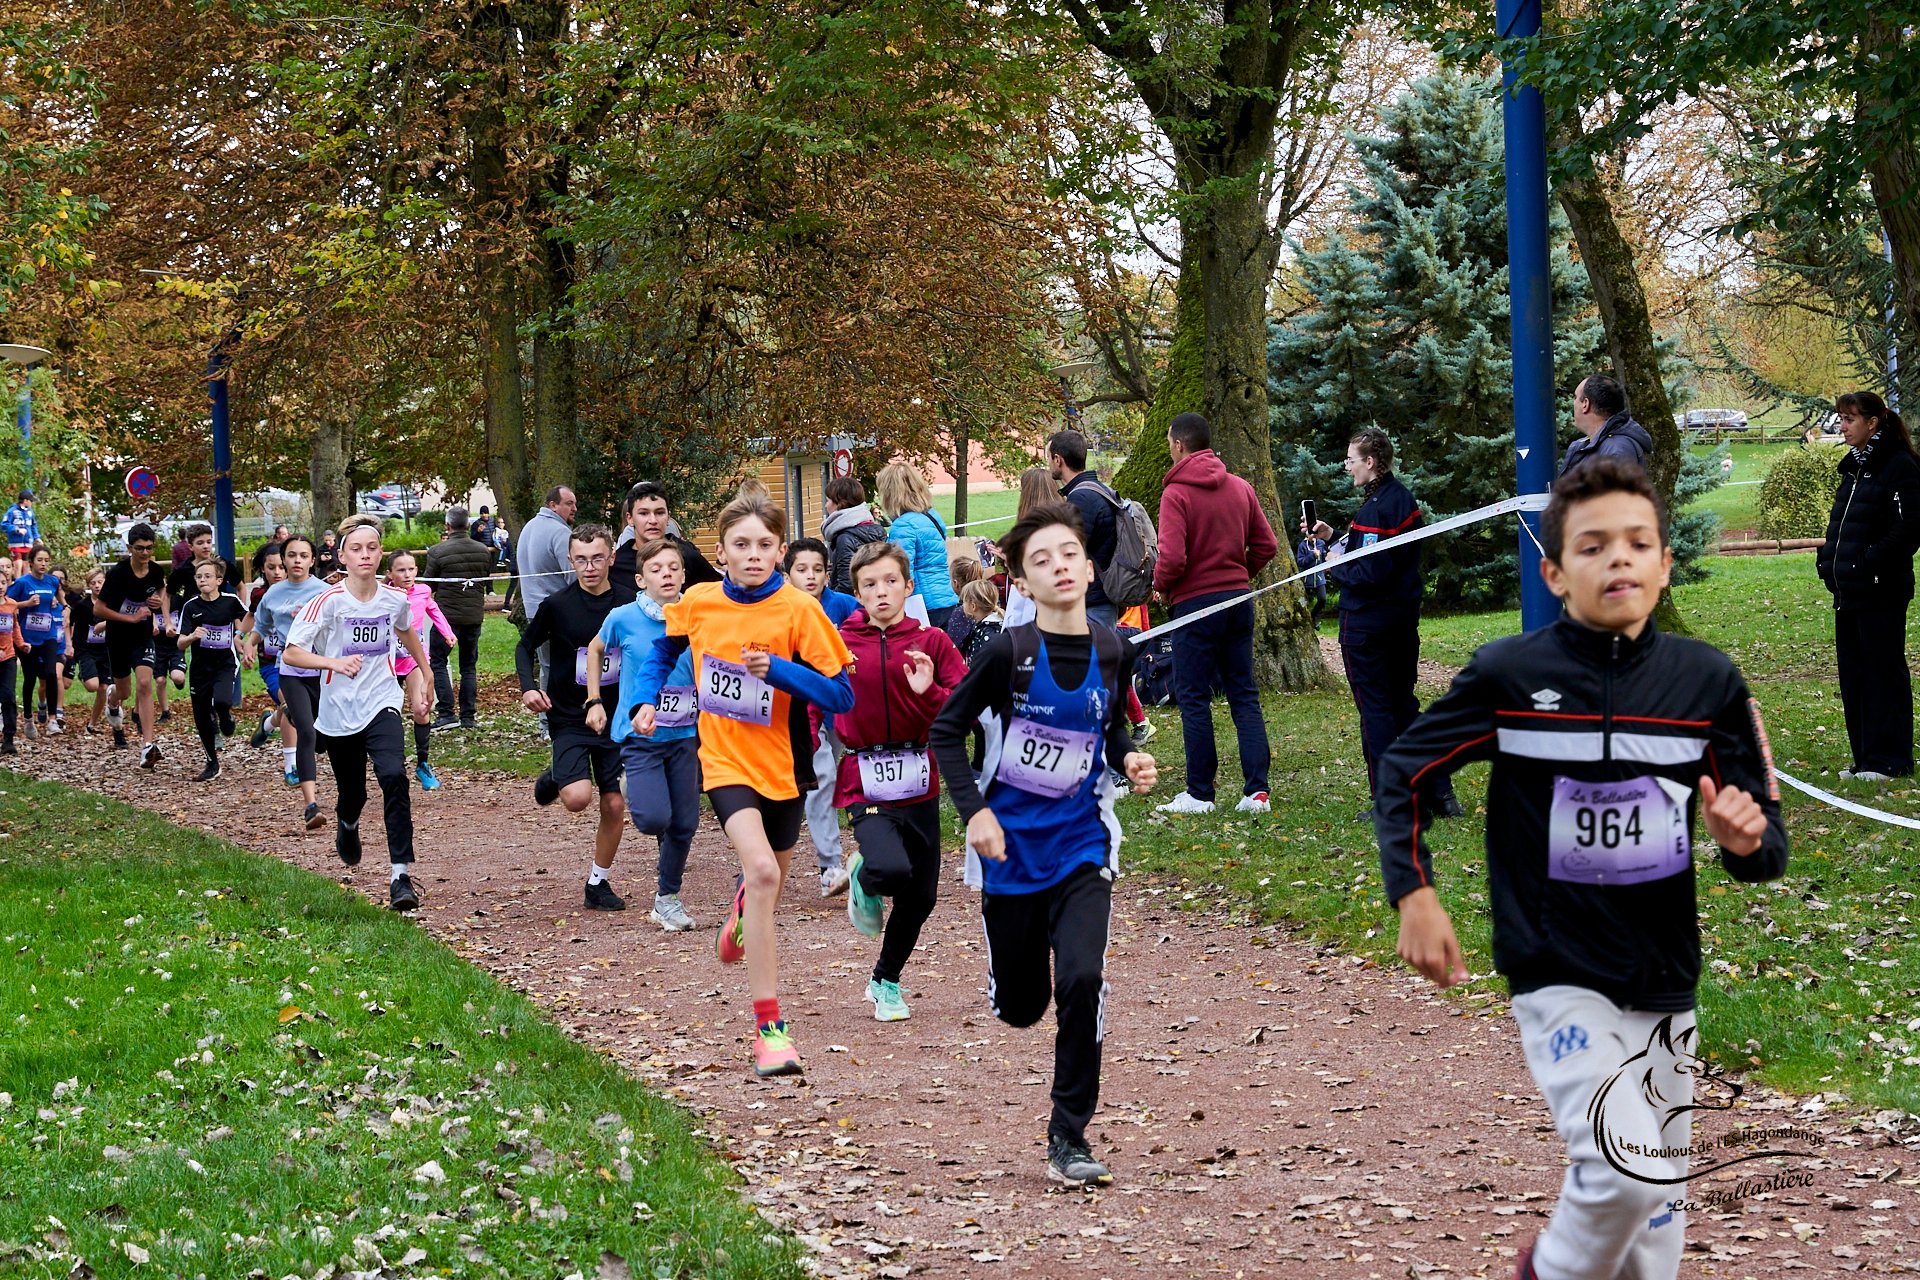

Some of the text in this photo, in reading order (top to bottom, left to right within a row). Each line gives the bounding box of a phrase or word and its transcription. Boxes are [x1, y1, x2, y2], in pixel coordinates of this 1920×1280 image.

[206, 631, 222, 641] 955
[268, 635, 279, 647] 92
[352, 626, 378, 643] 960
[710, 671, 742, 701] 923
[1020, 738, 1065, 773] 927
[874, 759, 903, 783] 957
[1570, 788, 1586, 803] La
[1575, 804, 1644, 850] 964
